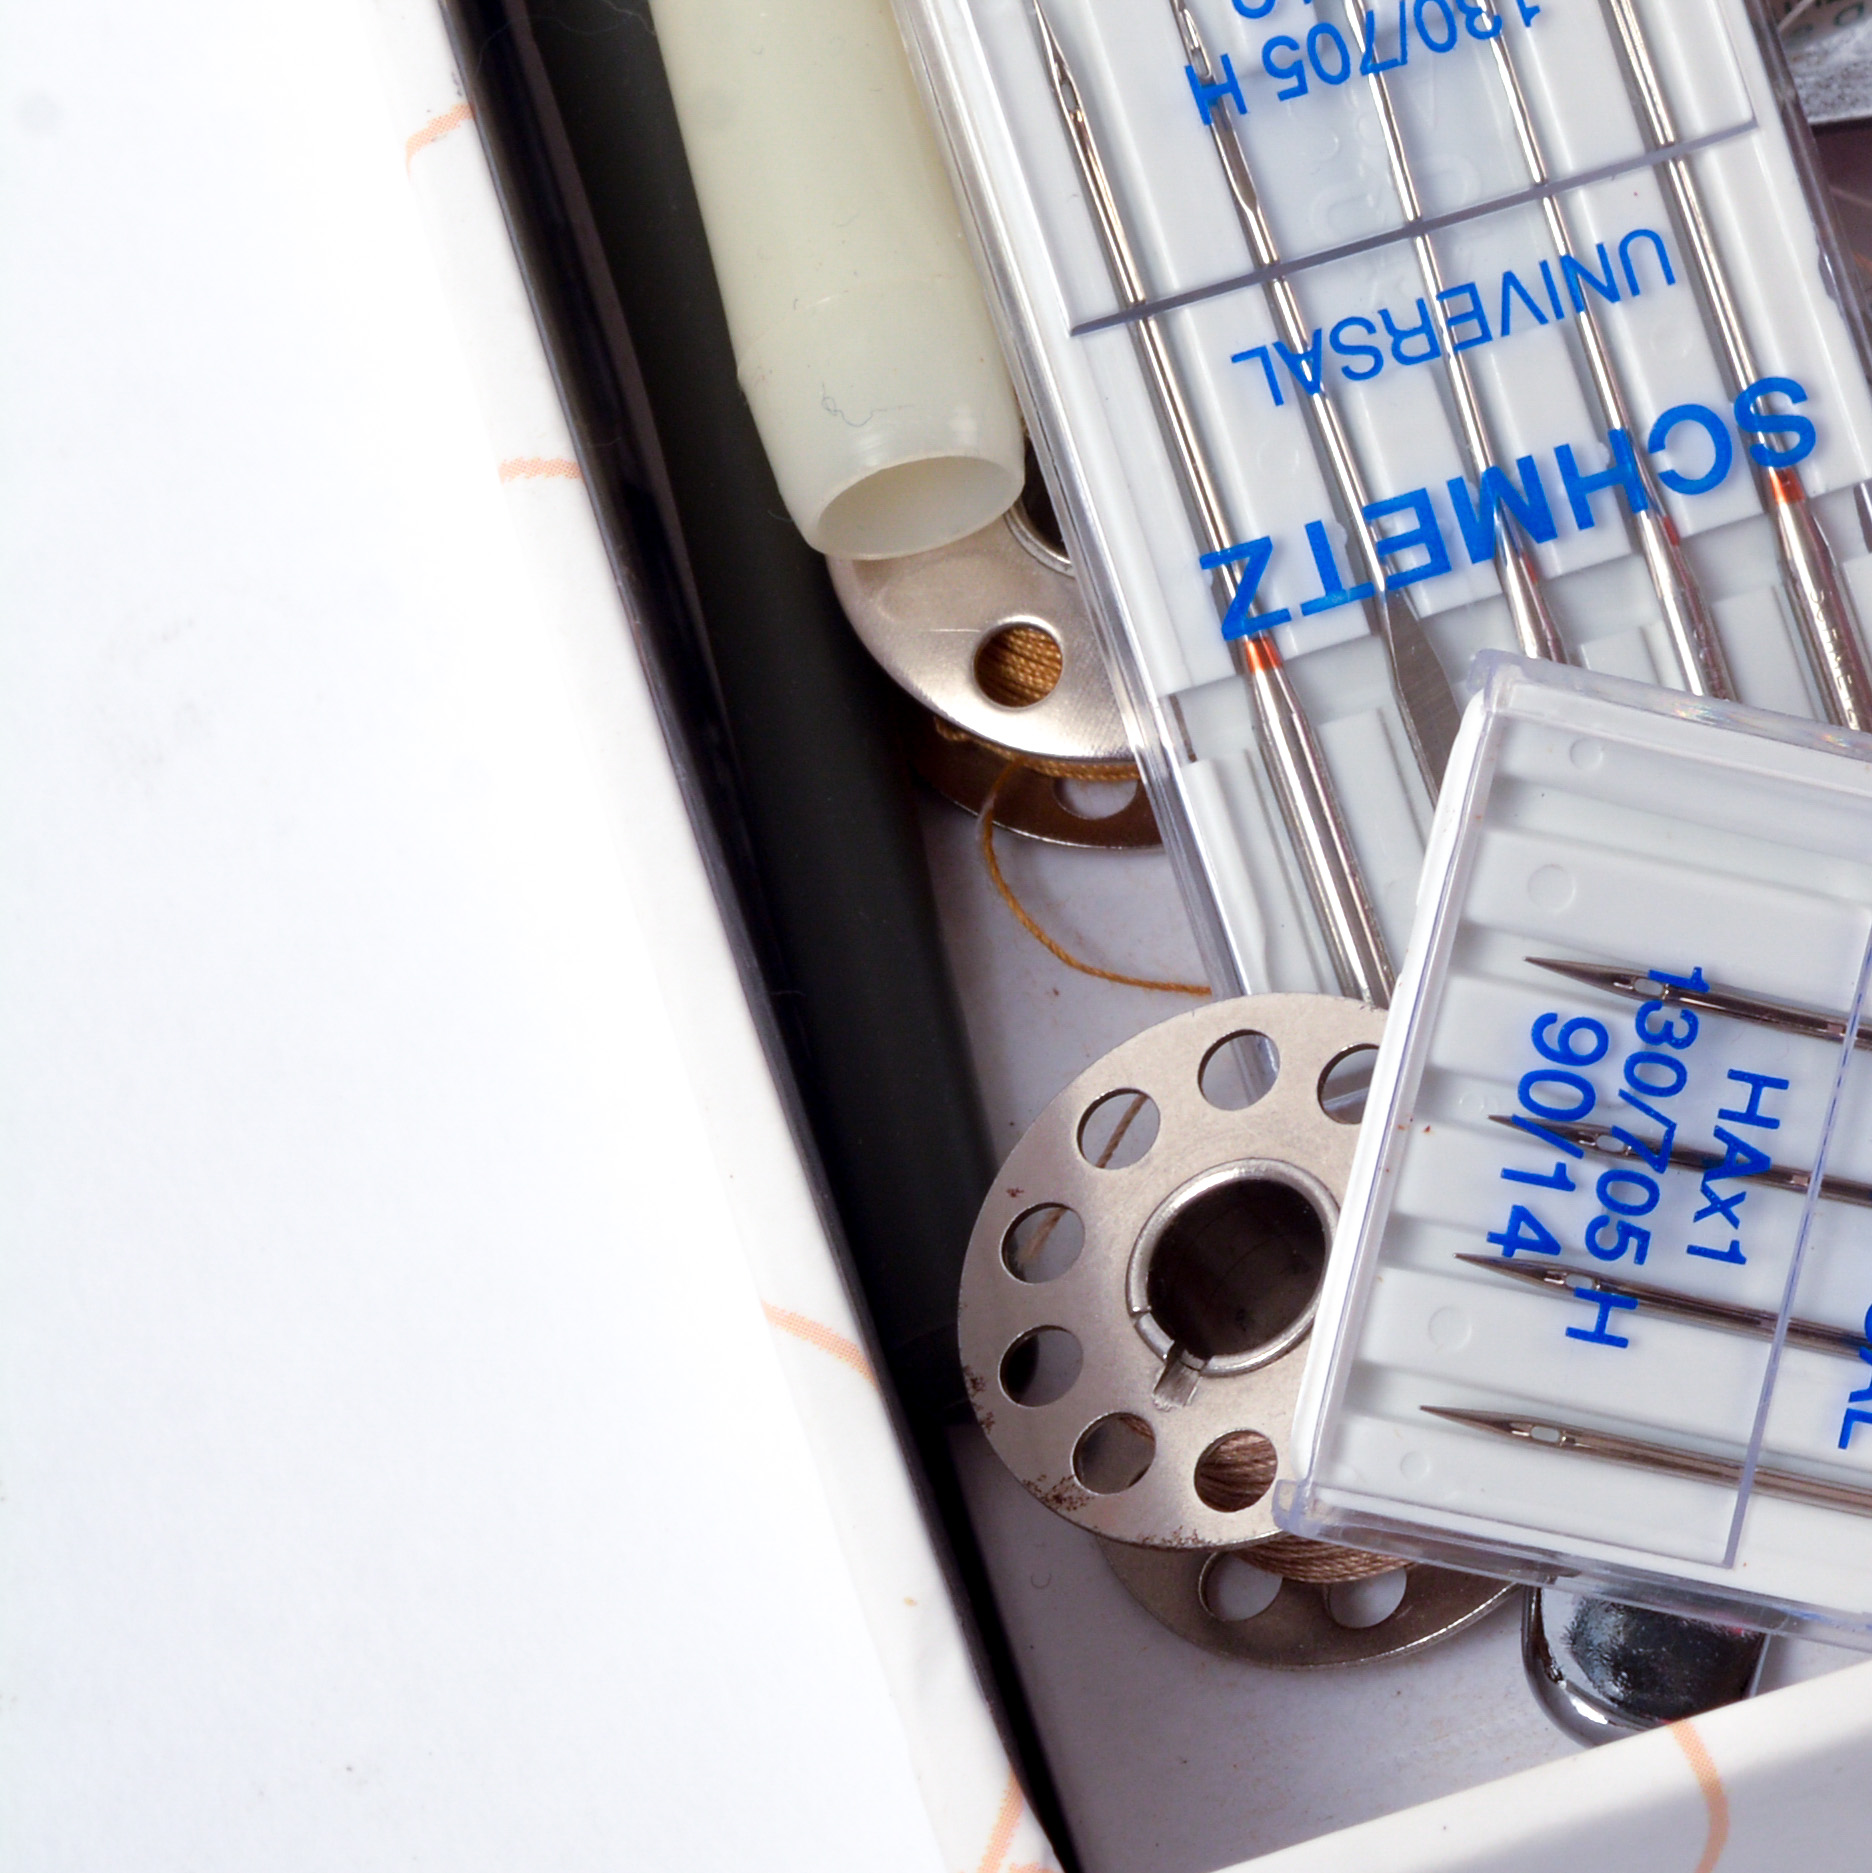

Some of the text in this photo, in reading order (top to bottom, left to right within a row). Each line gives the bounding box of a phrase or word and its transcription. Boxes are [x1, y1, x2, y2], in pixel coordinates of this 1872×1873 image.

[1185, 54, 1248, 126] H
[1231, 229, 1676, 406] UNIVERSAL
[1199, 376, 1818, 642] SCHMETZ
[1487, 1012, 1612, 1258] 90/14
[1566, 967, 1710, 1349] 130/705 H
[1686, 1068, 1790, 1265] HAx1
